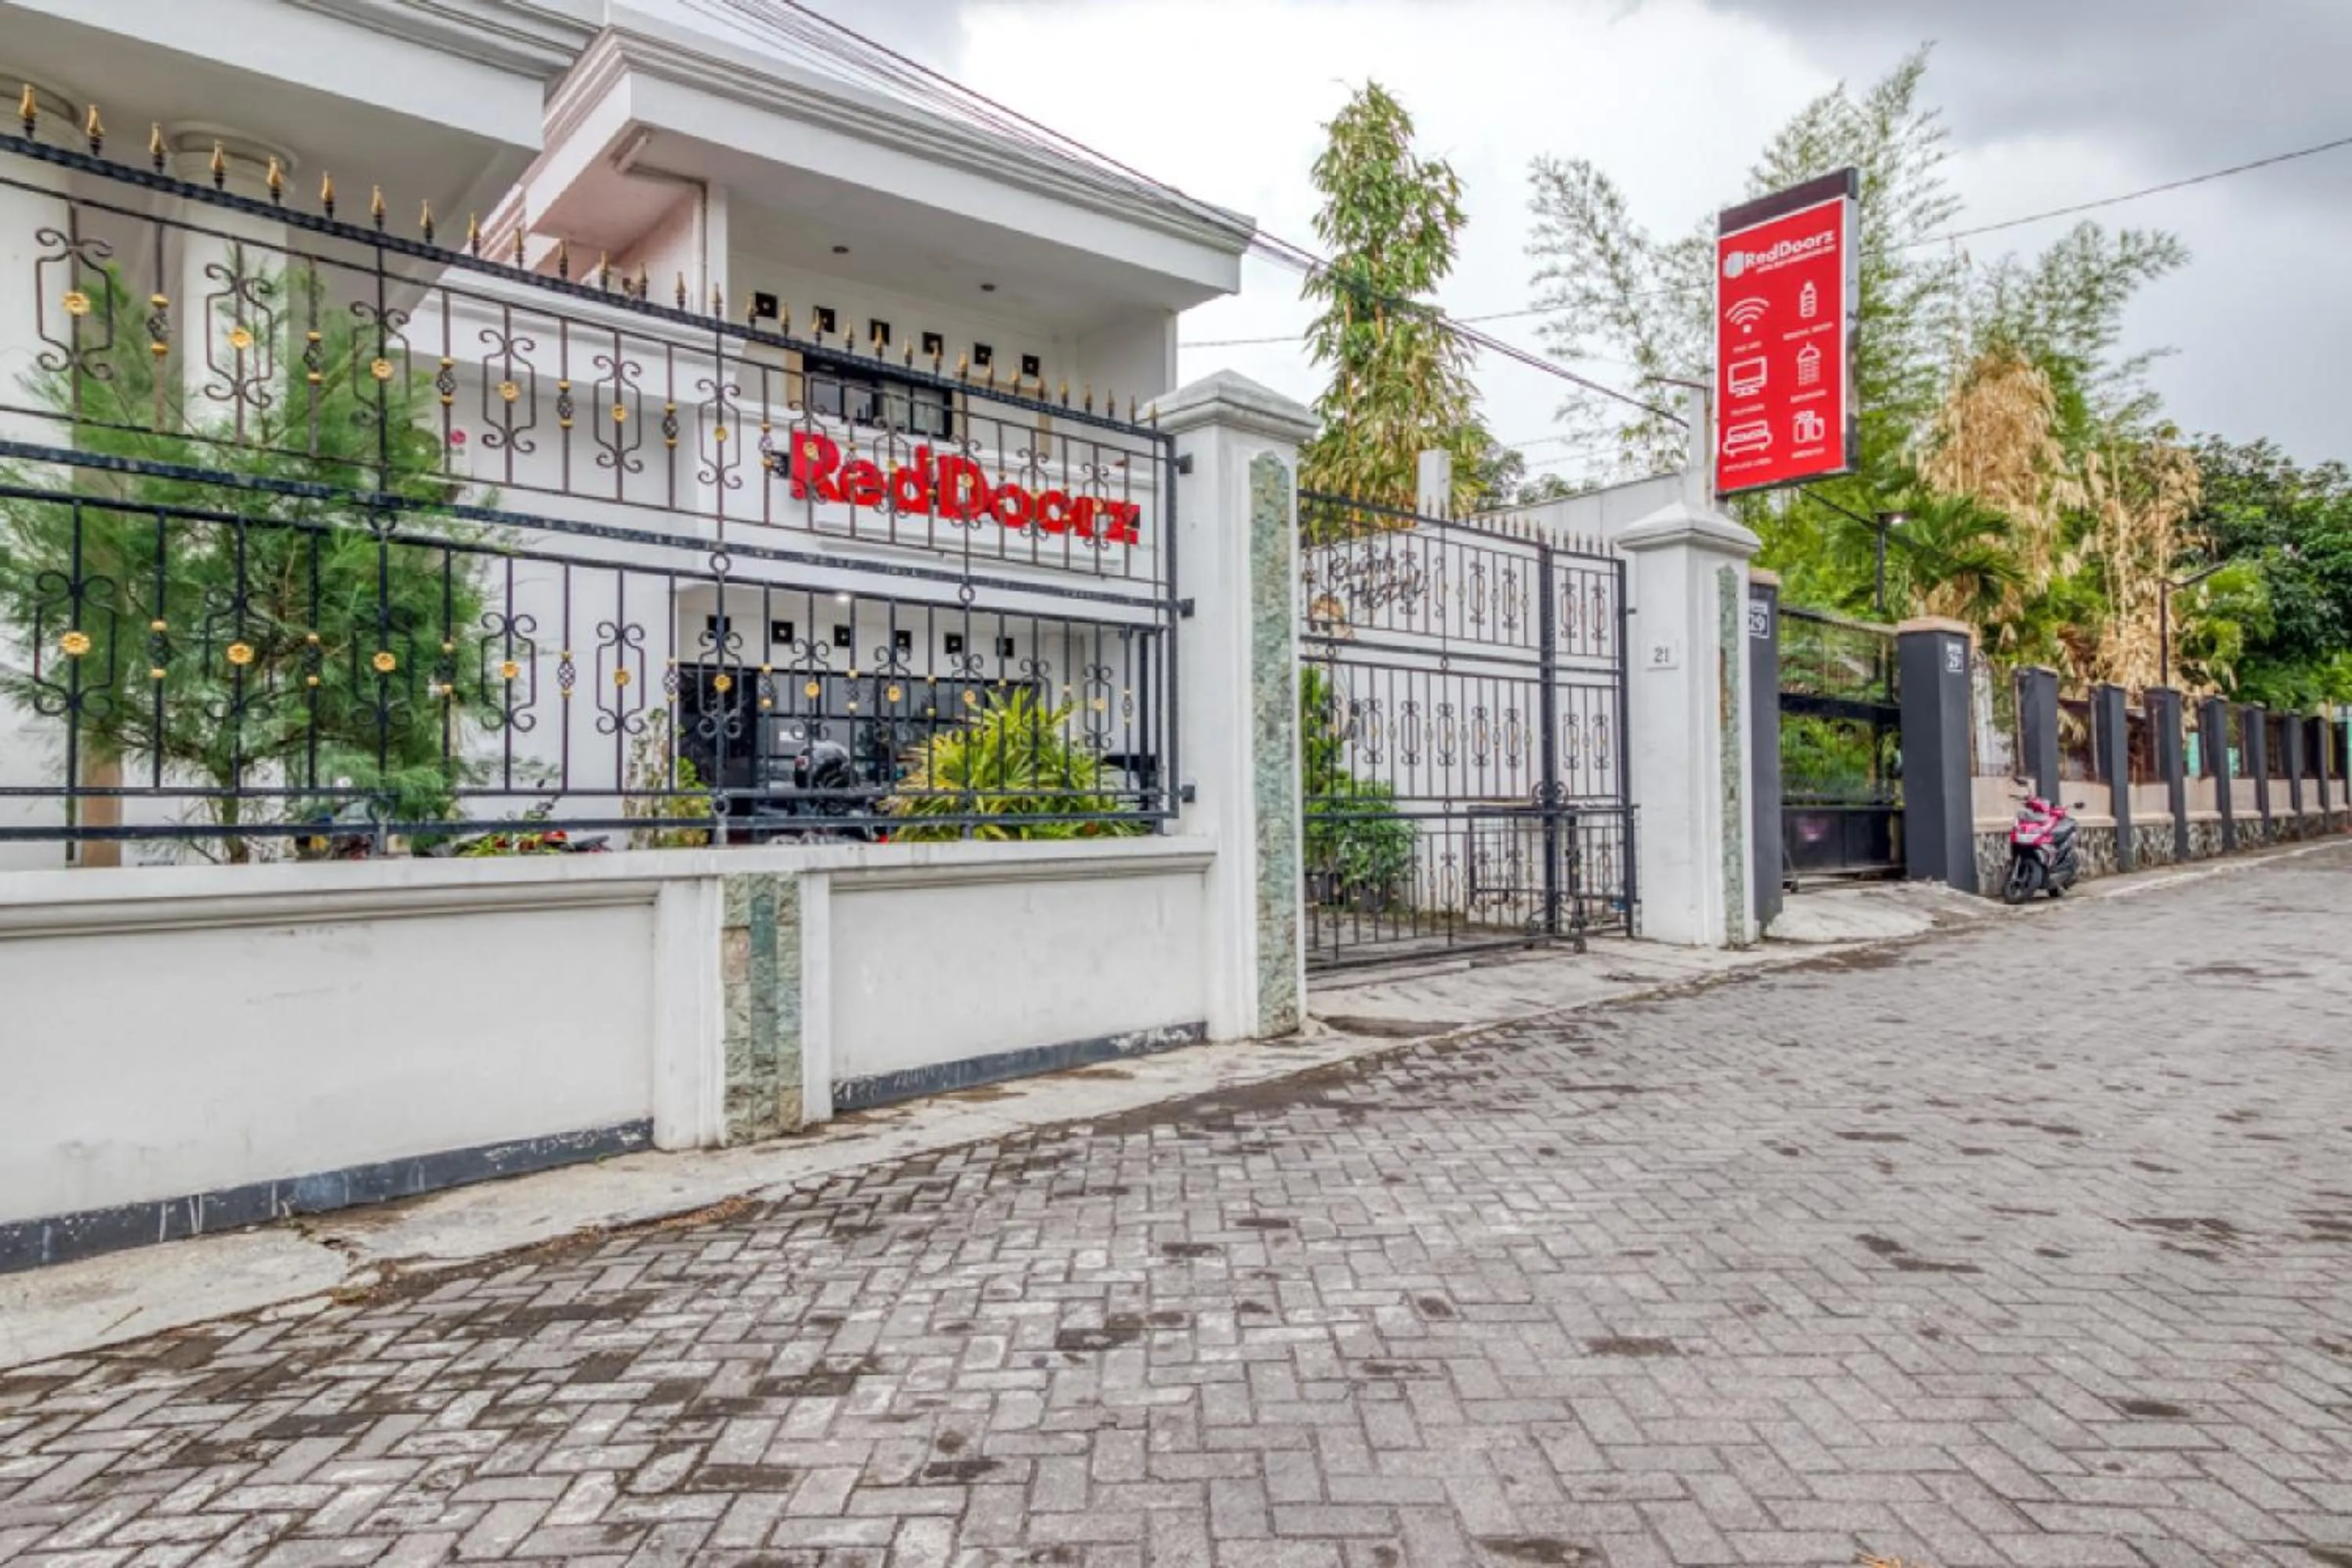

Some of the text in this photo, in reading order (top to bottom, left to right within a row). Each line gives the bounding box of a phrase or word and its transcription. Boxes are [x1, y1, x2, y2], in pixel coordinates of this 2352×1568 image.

[1744, 230, 1835, 269] RedDoorz
[790, 430, 1141, 544] RedDoorz
[1653, 647, 1669, 662] 21
